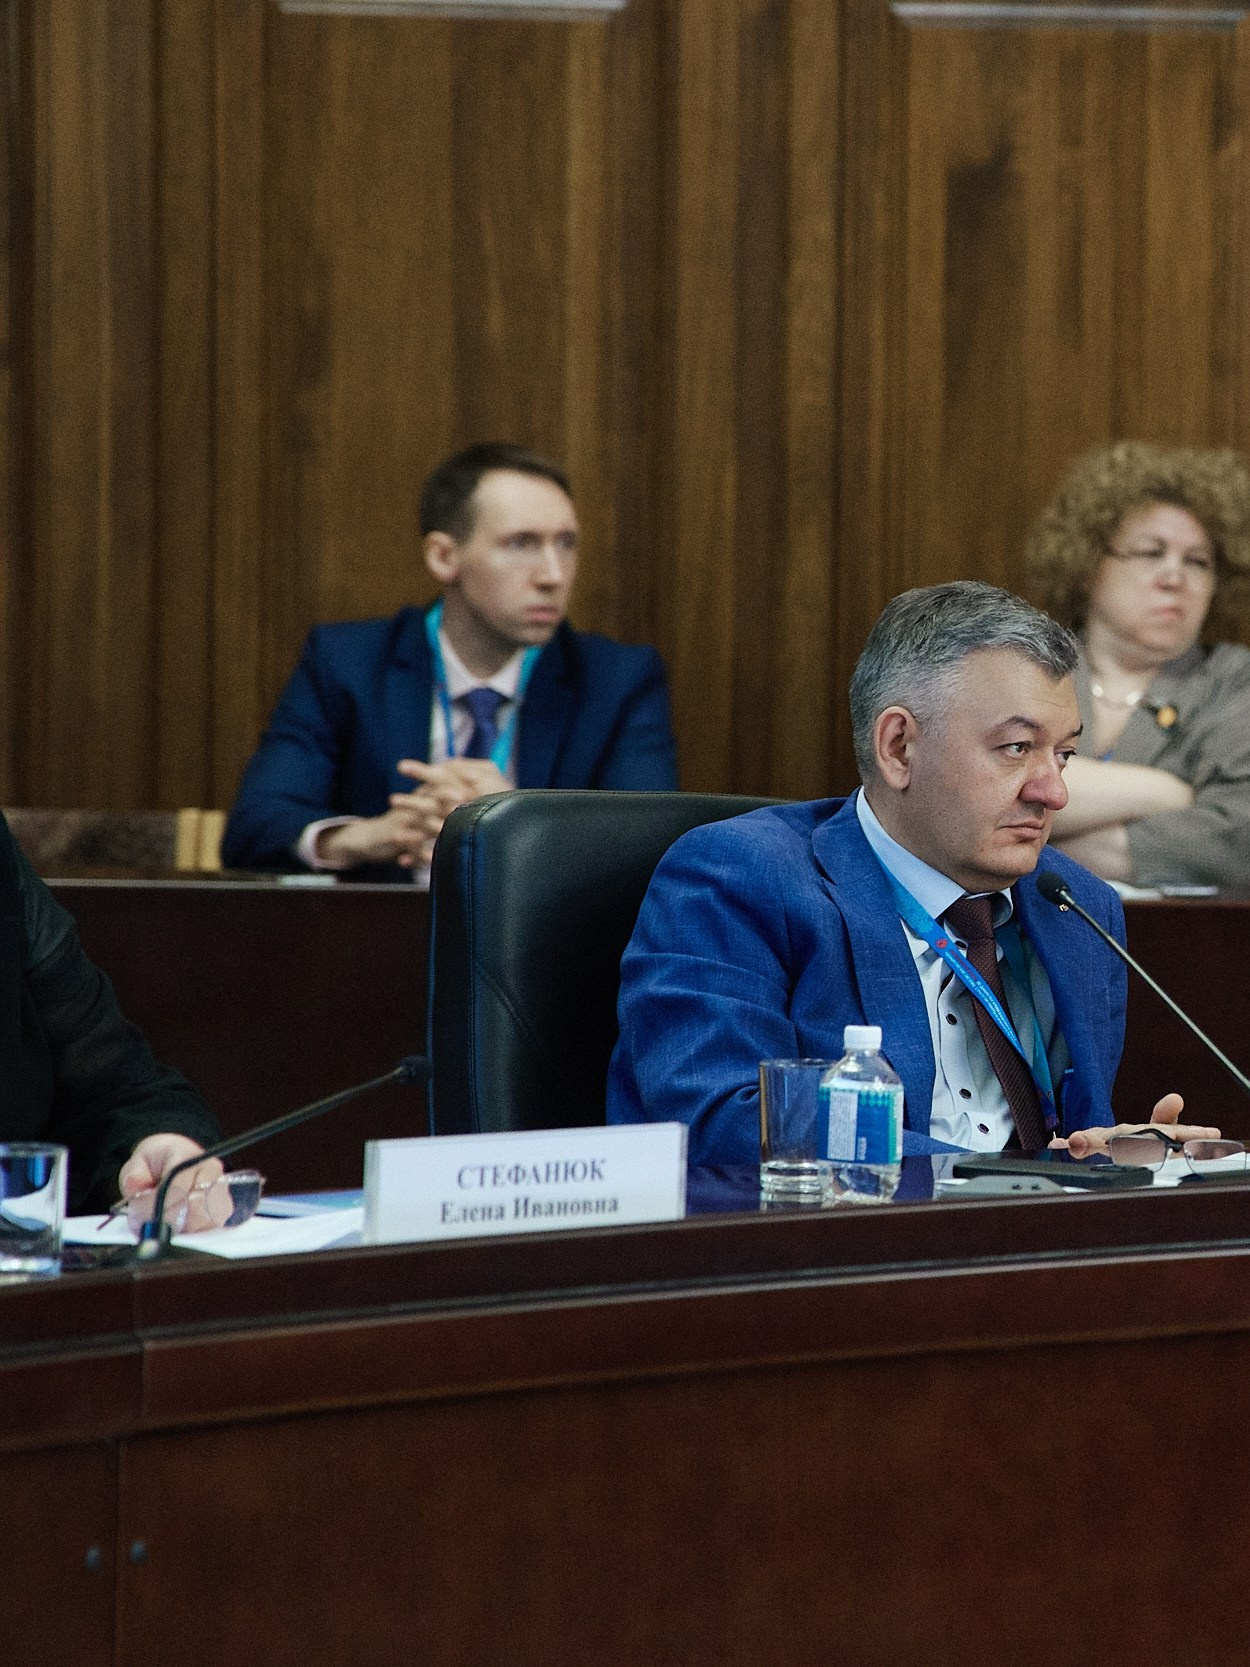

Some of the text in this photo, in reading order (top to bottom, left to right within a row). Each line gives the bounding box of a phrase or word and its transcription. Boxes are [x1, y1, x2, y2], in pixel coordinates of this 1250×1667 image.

[457, 1158, 606, 1189] СТЕФАНЮК
[440, 1196, 619, 1224] Елена Ивановна
